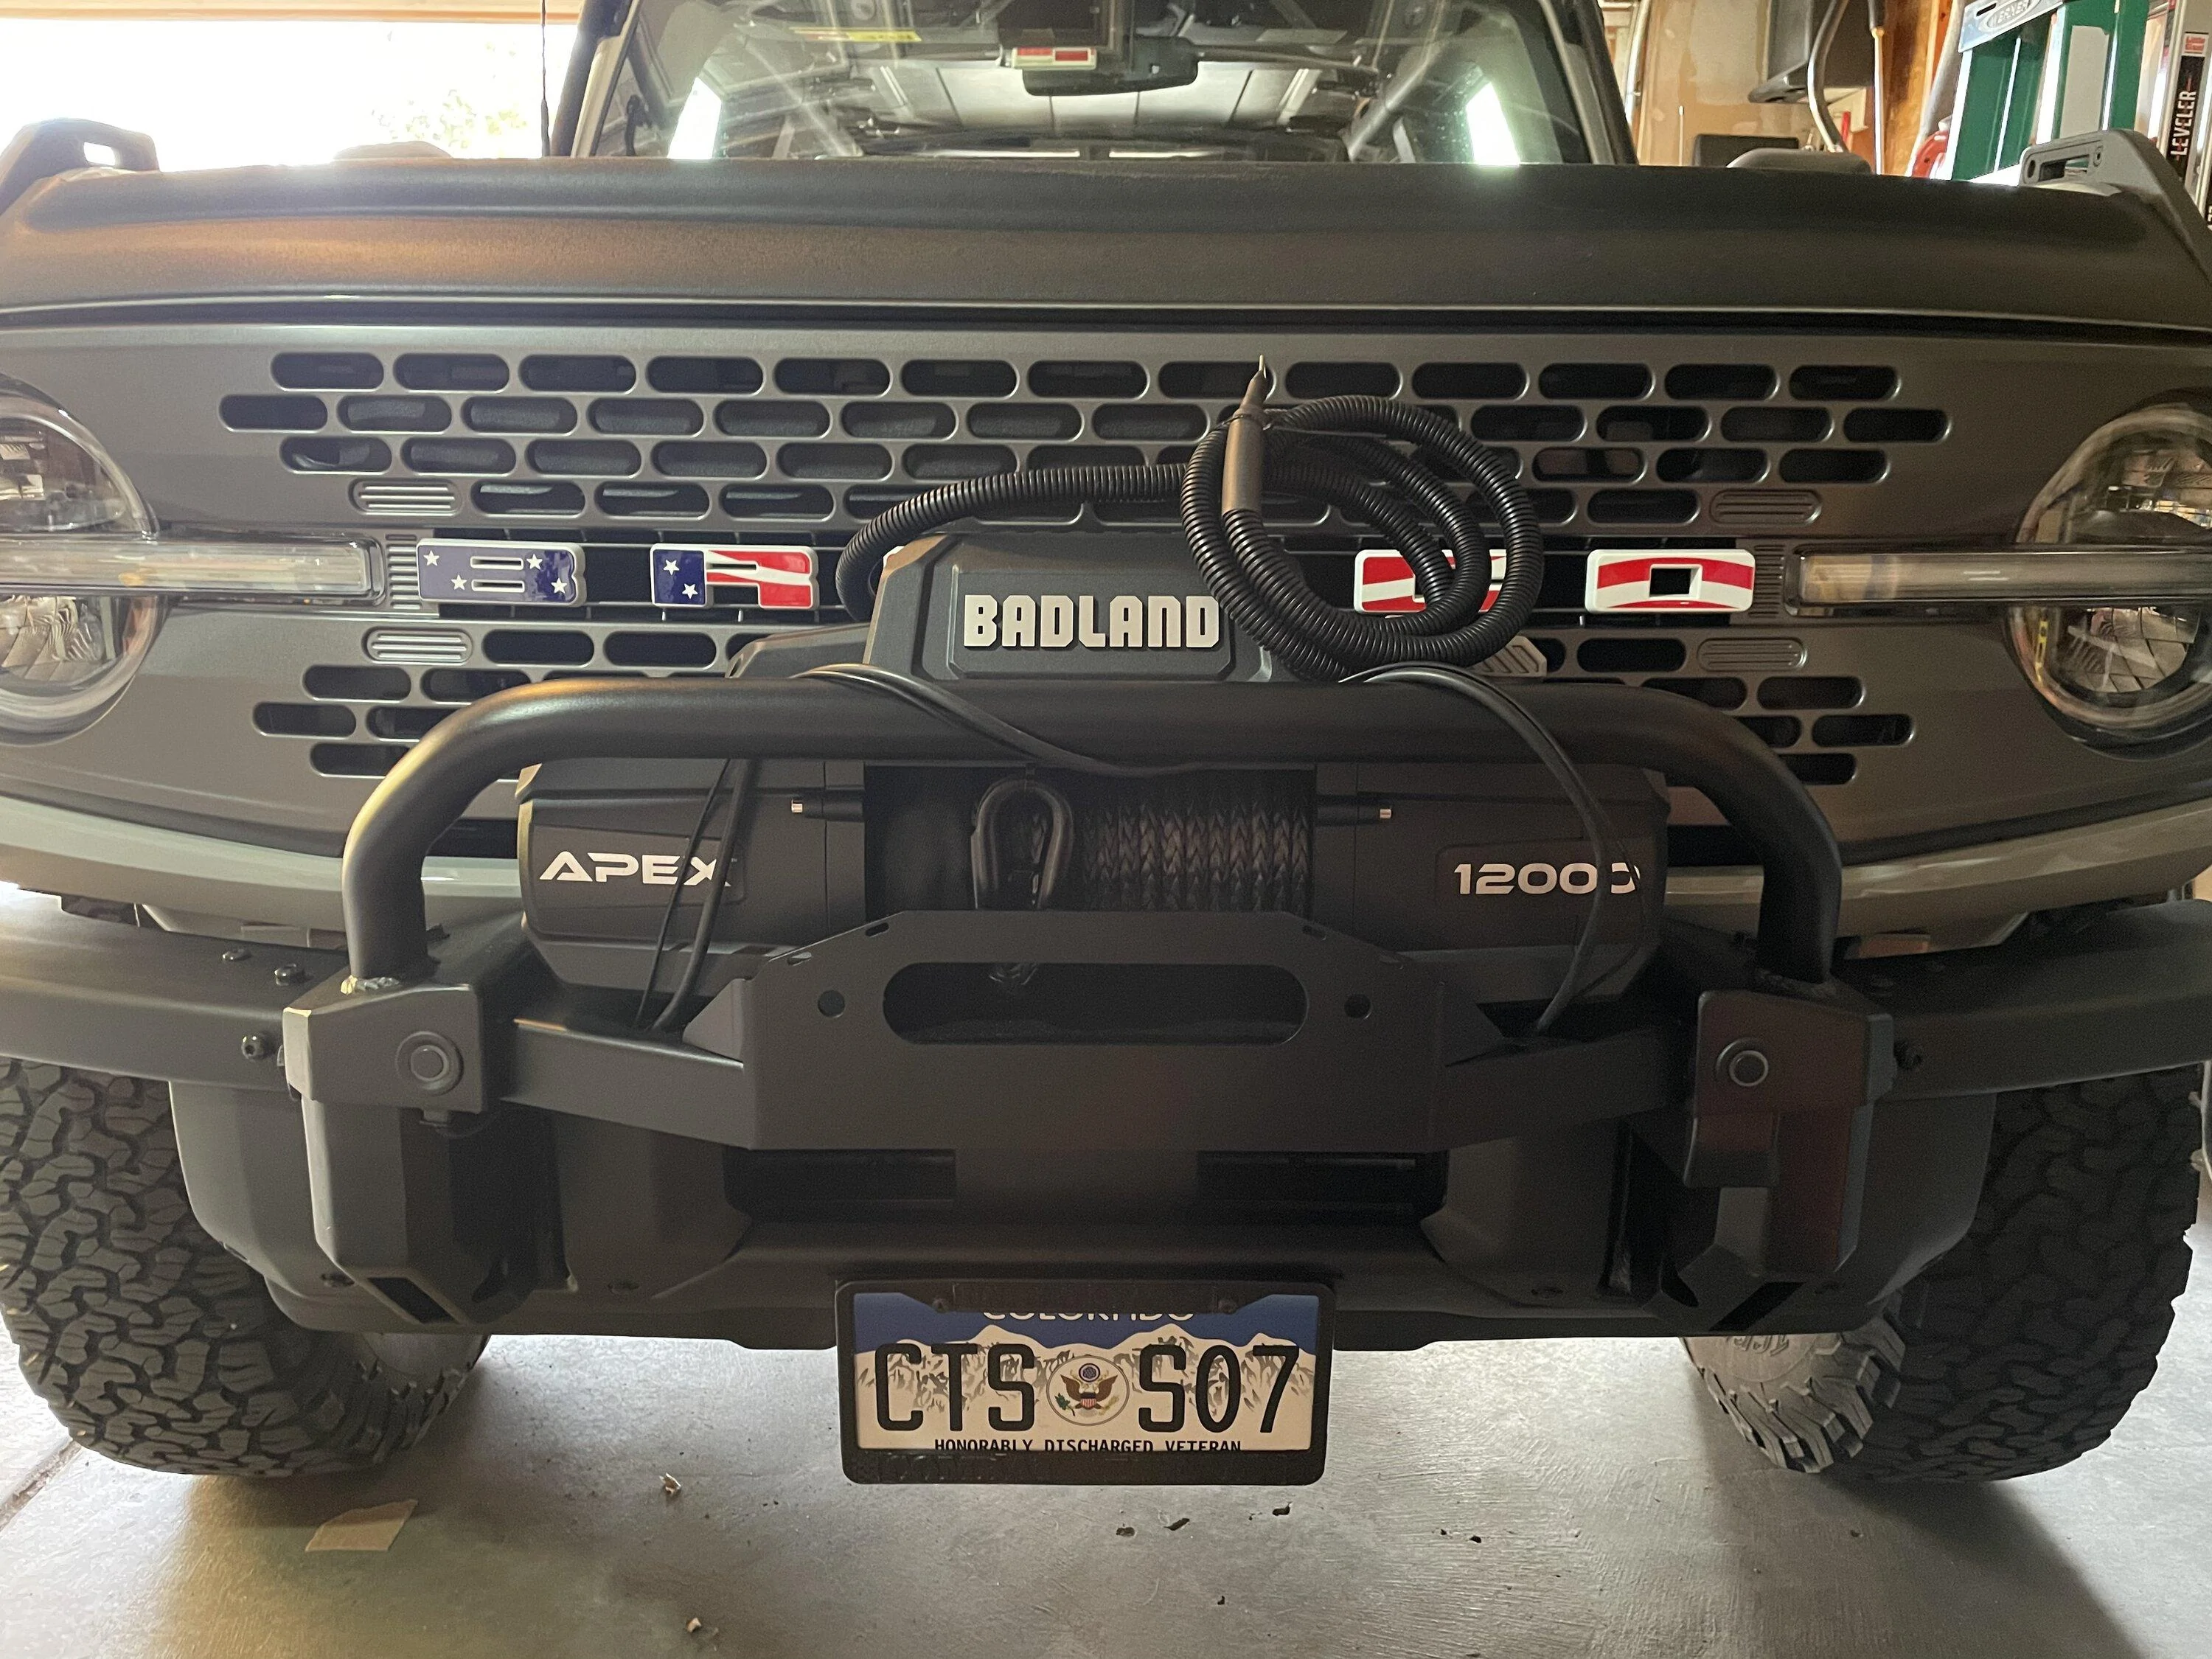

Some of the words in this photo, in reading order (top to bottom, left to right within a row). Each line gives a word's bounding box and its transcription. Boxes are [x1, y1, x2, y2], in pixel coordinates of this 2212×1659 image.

[2170, 91, 2197, 156] LEVELER
[964, 594, 1220, 648] BADLAND
[539, 851, 731, 887] APEX
[874, 1343, 1035, 1432] CTS
[1138, 1344, 1300, 1433] S07
[934, 1439, 1033, 1451] HONORABLY
[1044, 1439, 1154, 1452] DISCHARGED
[1164, 1440, 1242, 1452] VETERAN
